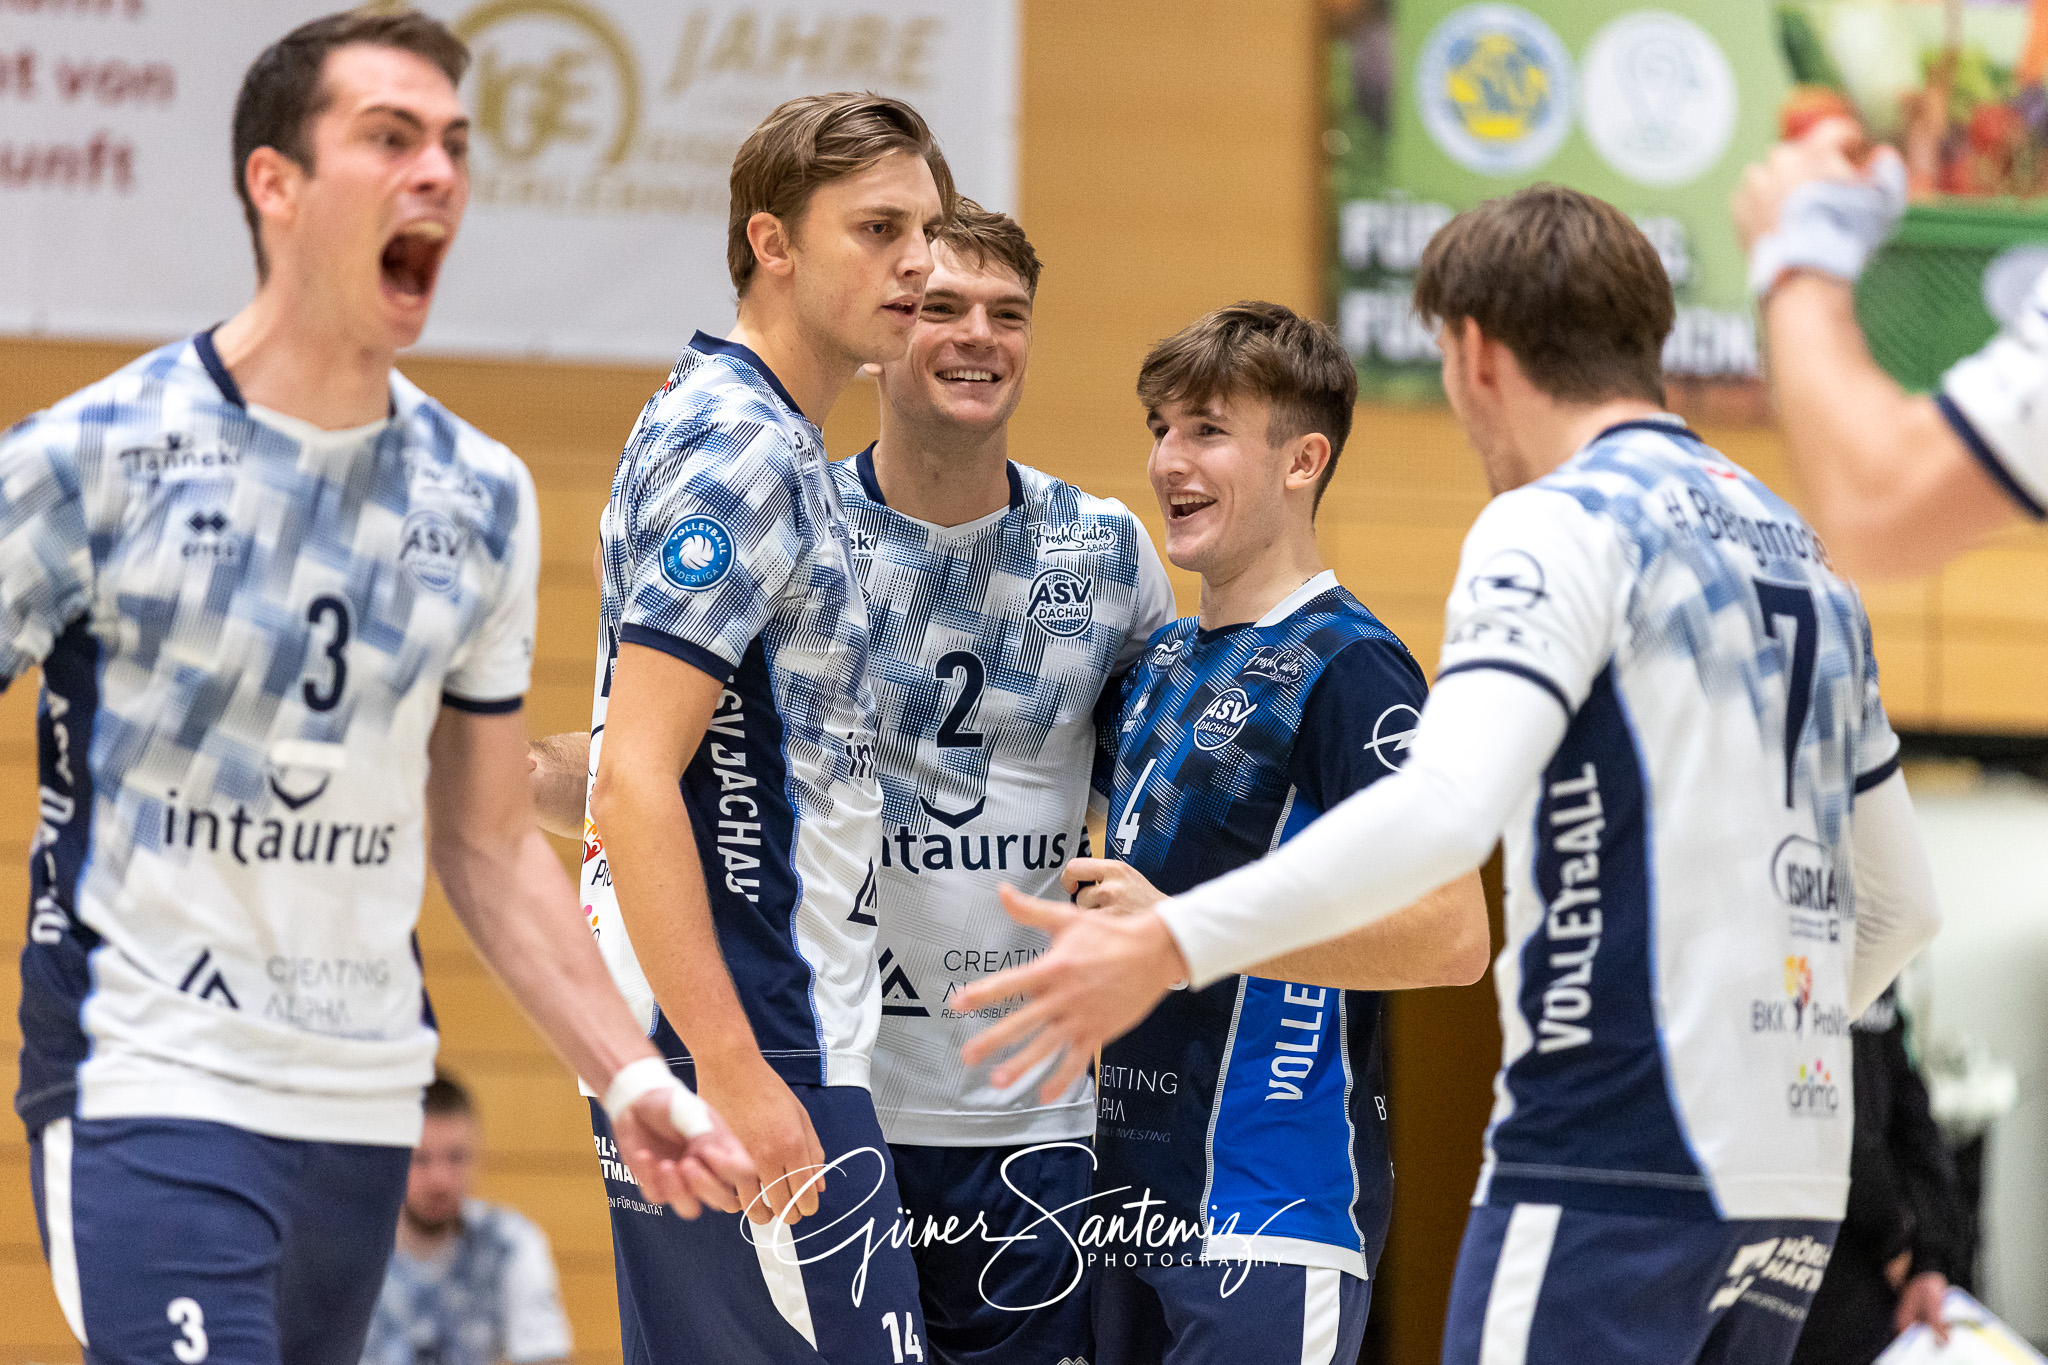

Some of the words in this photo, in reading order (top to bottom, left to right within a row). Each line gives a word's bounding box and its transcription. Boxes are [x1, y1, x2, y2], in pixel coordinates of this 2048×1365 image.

[671, 522, 728, 555] VOLLEYBALL
[667, 555, 719, 583] BUNDESLIGA
[1026, 577, 1093, 618] ASV
[1038, 606, 1089, 619] DACHAU
[302, 594, 352, 712] 3
[934, 650, 986, 749] 2
[1193, 699, 1259, 730] ASV
[1751, 574, 1819, 811] 7
[1198, 720, 1237, 738] DACHAU
[162, 787, 397, 867] intaurus
[1115, 758, 1157, 855] 4
[167, 1297, 209, 1364] 3
[881, 1311, 924, 1364] 14
